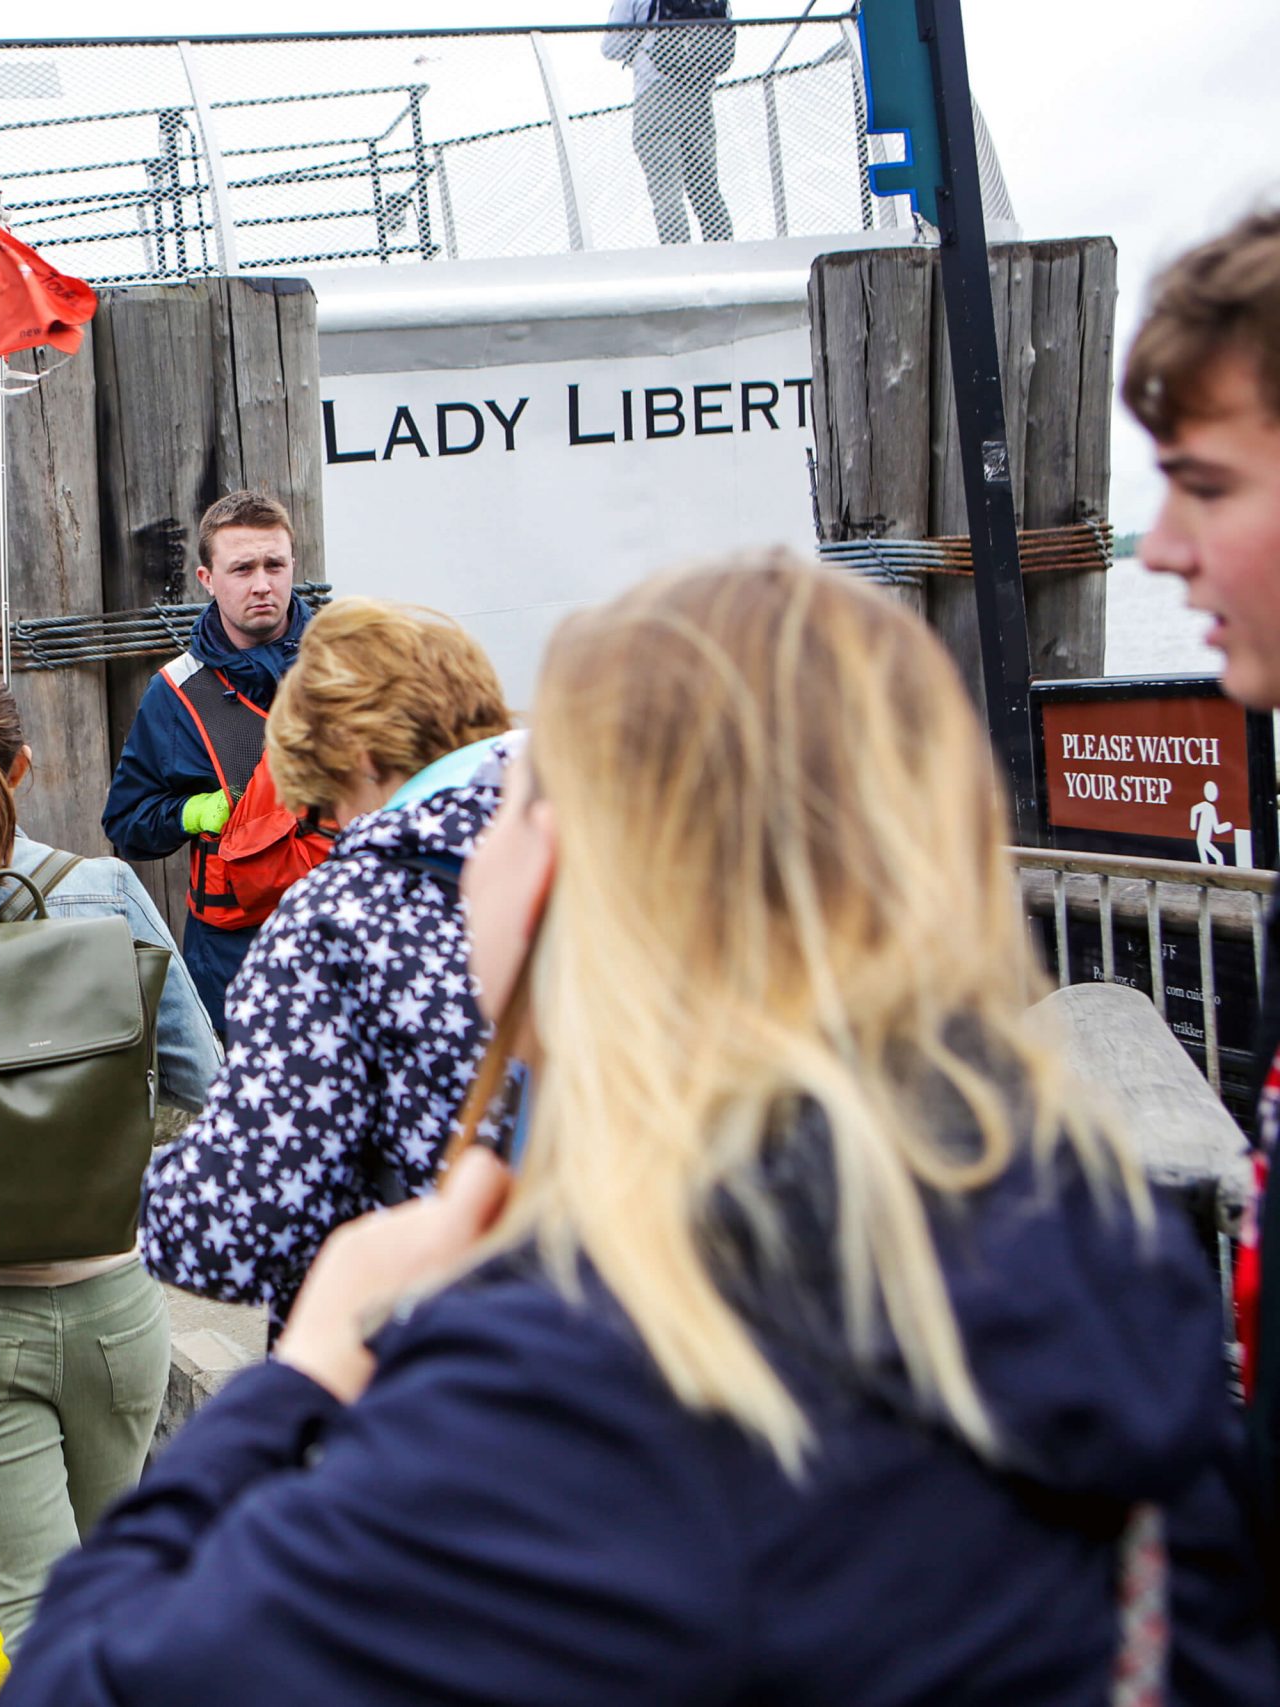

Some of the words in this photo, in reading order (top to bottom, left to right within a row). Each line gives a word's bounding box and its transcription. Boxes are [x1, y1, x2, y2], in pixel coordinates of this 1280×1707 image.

[321, 396, 530, 464] LADY
[567, 378, 813, 446] LIBERT
[1061, 733, 1134, 762] PLEASE
[1136, 736, 1220, 765] WATCH
[1063, 772, 1118, 801] YOUR
[1121, 775, 1171, 805] STEP
[1186, 987, 1221, 1006] cuido
